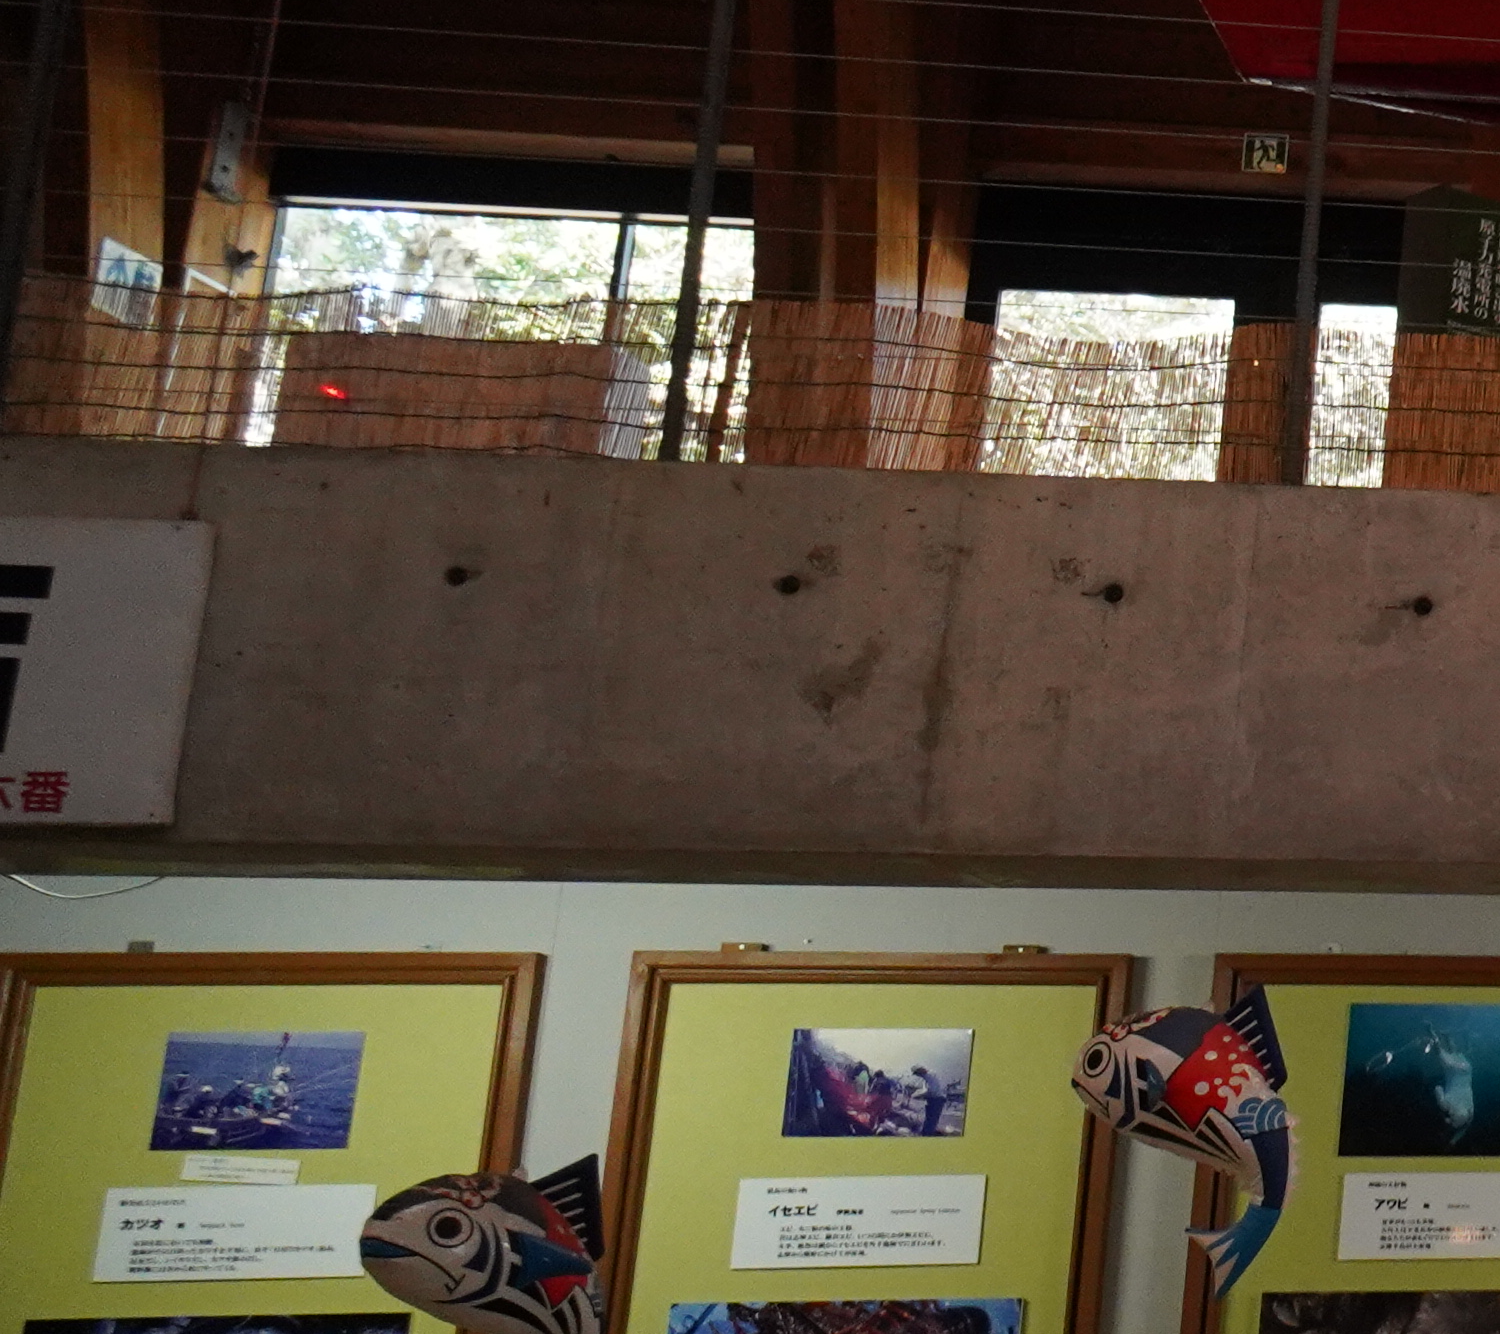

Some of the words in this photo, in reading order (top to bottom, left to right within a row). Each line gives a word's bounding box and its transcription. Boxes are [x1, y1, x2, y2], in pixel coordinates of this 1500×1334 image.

[1473, 218, 1495, 319] 原子力発電所の
[768, 1203, 819, 1217] イセエビ
[1374, 1197, 1409, 1212] アワビ
[120, 1218, 164, 1231] カツオ
